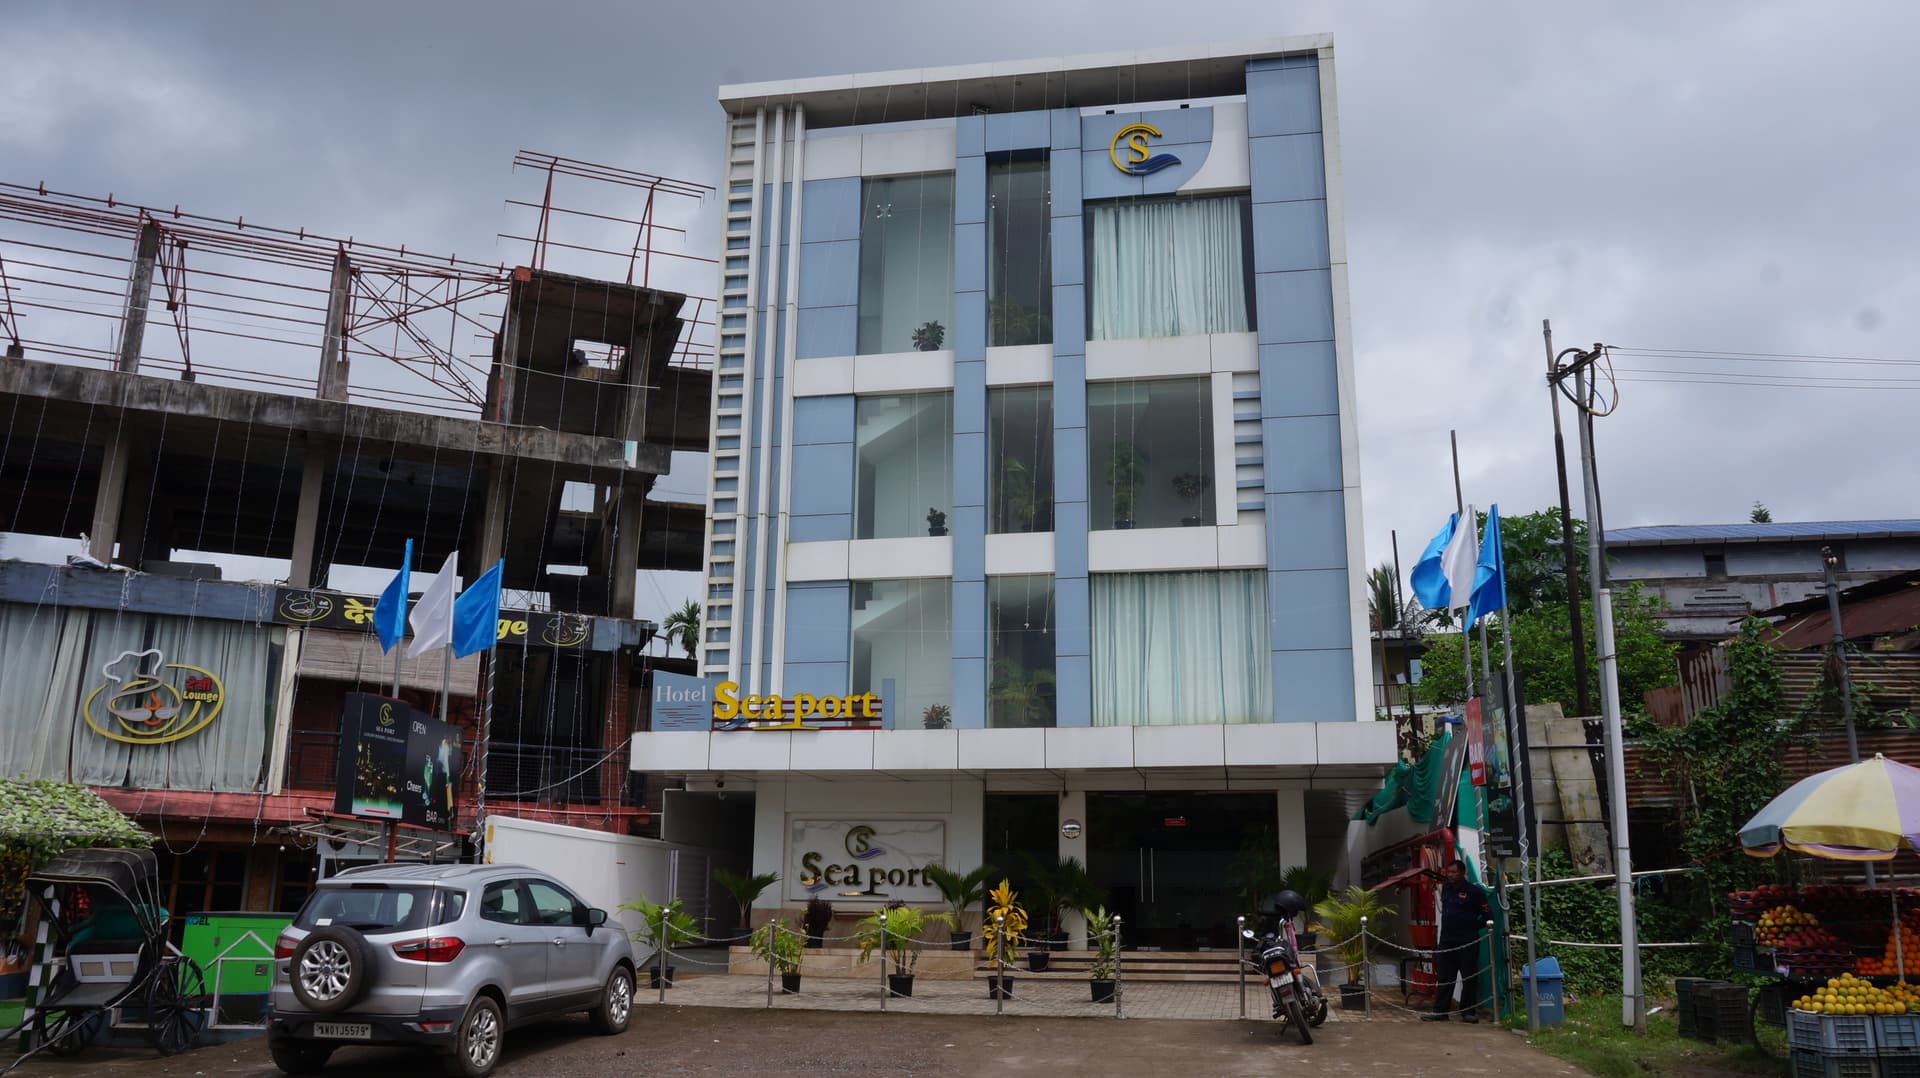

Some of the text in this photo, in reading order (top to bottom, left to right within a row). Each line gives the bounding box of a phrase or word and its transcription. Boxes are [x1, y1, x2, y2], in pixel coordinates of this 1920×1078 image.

[183, 691, 218, 703] Lounge
[655, 680, 879, 731] Hotel Sea port
[412, 720, 427, 735] OPEN
[1469, 743, 1484, 764] BAR
[406, 780, 423, 793] Cheers
[426, 809, 438, 824] BAR
[800, 851, 932, 896] Sea port
